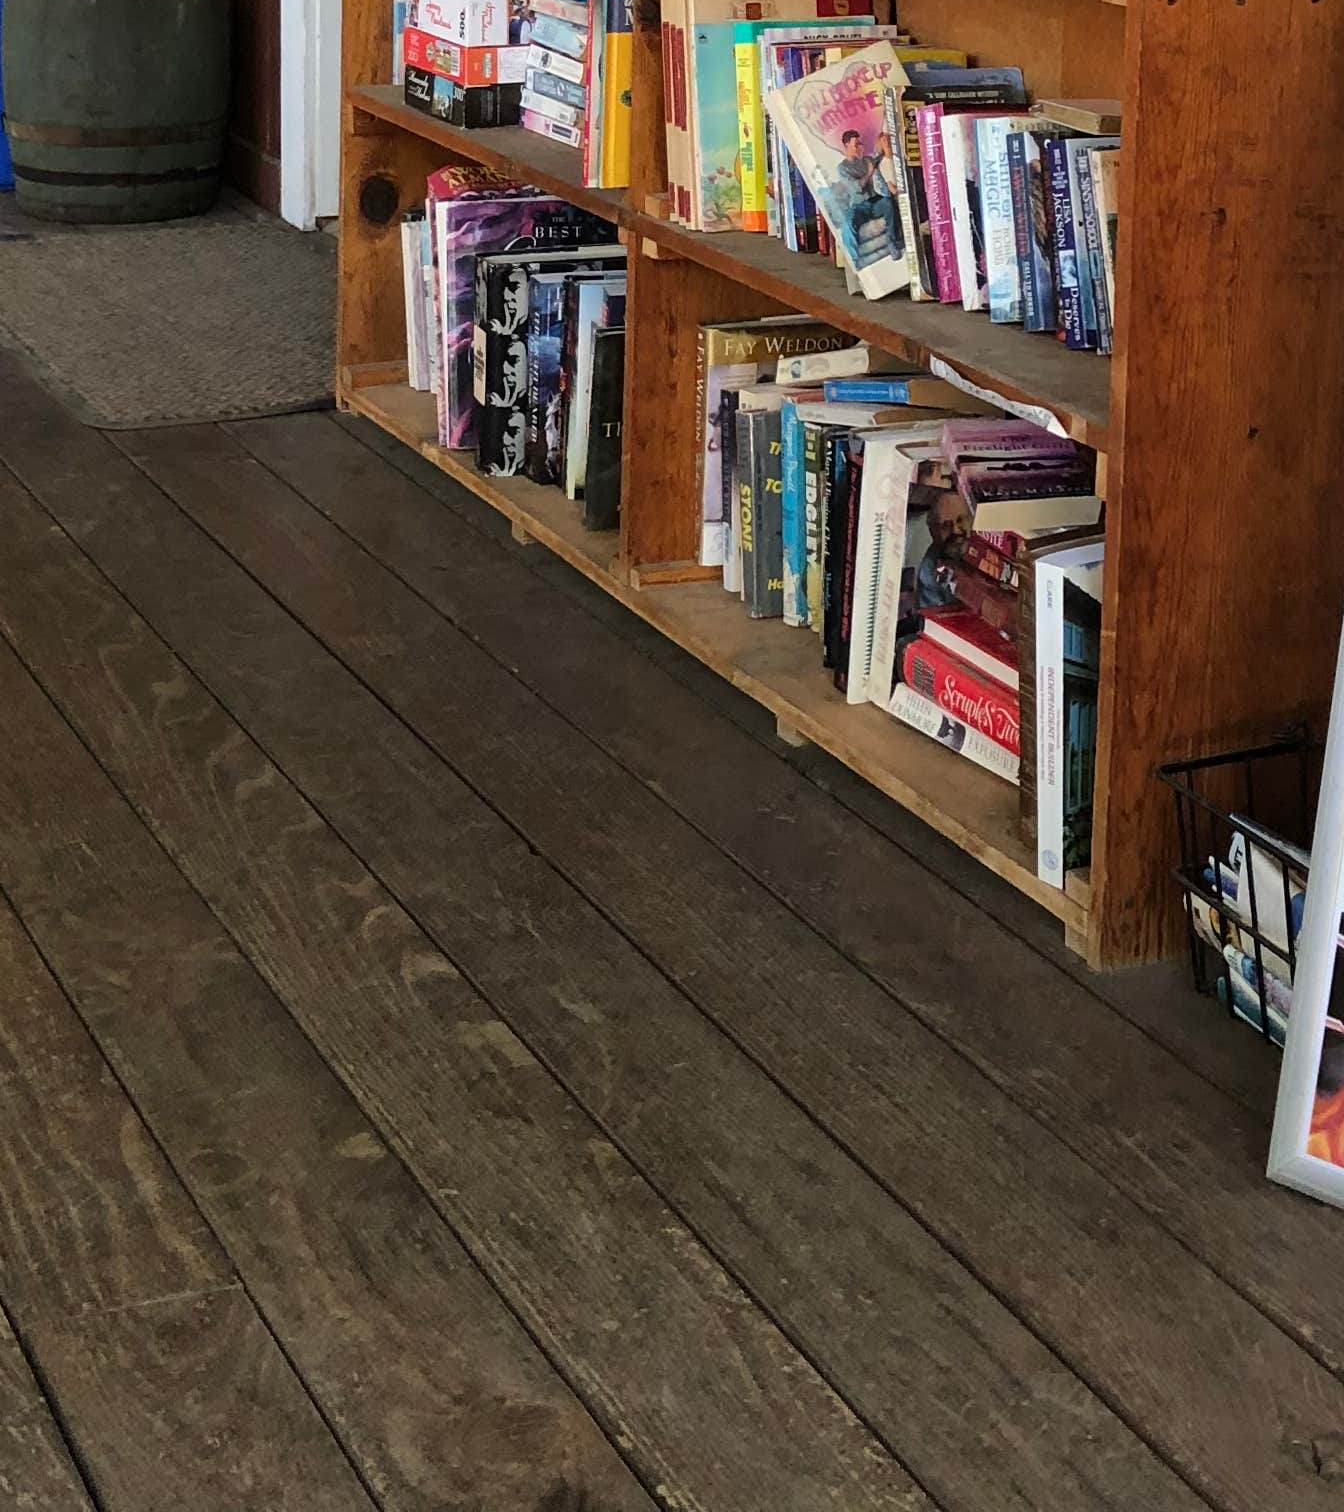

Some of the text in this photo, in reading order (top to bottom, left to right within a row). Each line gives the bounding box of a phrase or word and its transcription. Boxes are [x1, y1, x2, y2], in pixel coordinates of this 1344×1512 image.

[873, 61, 893, 80] UP
[984, 160, 1001, 219] MAGIC
[1063, 197, 1072, 224] LISA
[535, 225, 583, 238] BEST
[1052, 192, 1066, 248] JACKSON
[1064, 308, 1074, 330] Die
[1071, 287, 1083, 342] Deserves
[697, 345, 705, 376] FAY
[725, 336, 844, 356] FAY WELDON
[695, 379, 704, 443] WELDON
[739, 482, 753, 552] STONE
[805, 471, 818, 571] EDGLEY
[939, 674, 995, 737] Scruples
[1047, 666, 1056, 786] INDEPENDENT BUILDER
[968, 732, 1017, 773] EXPOSURE
